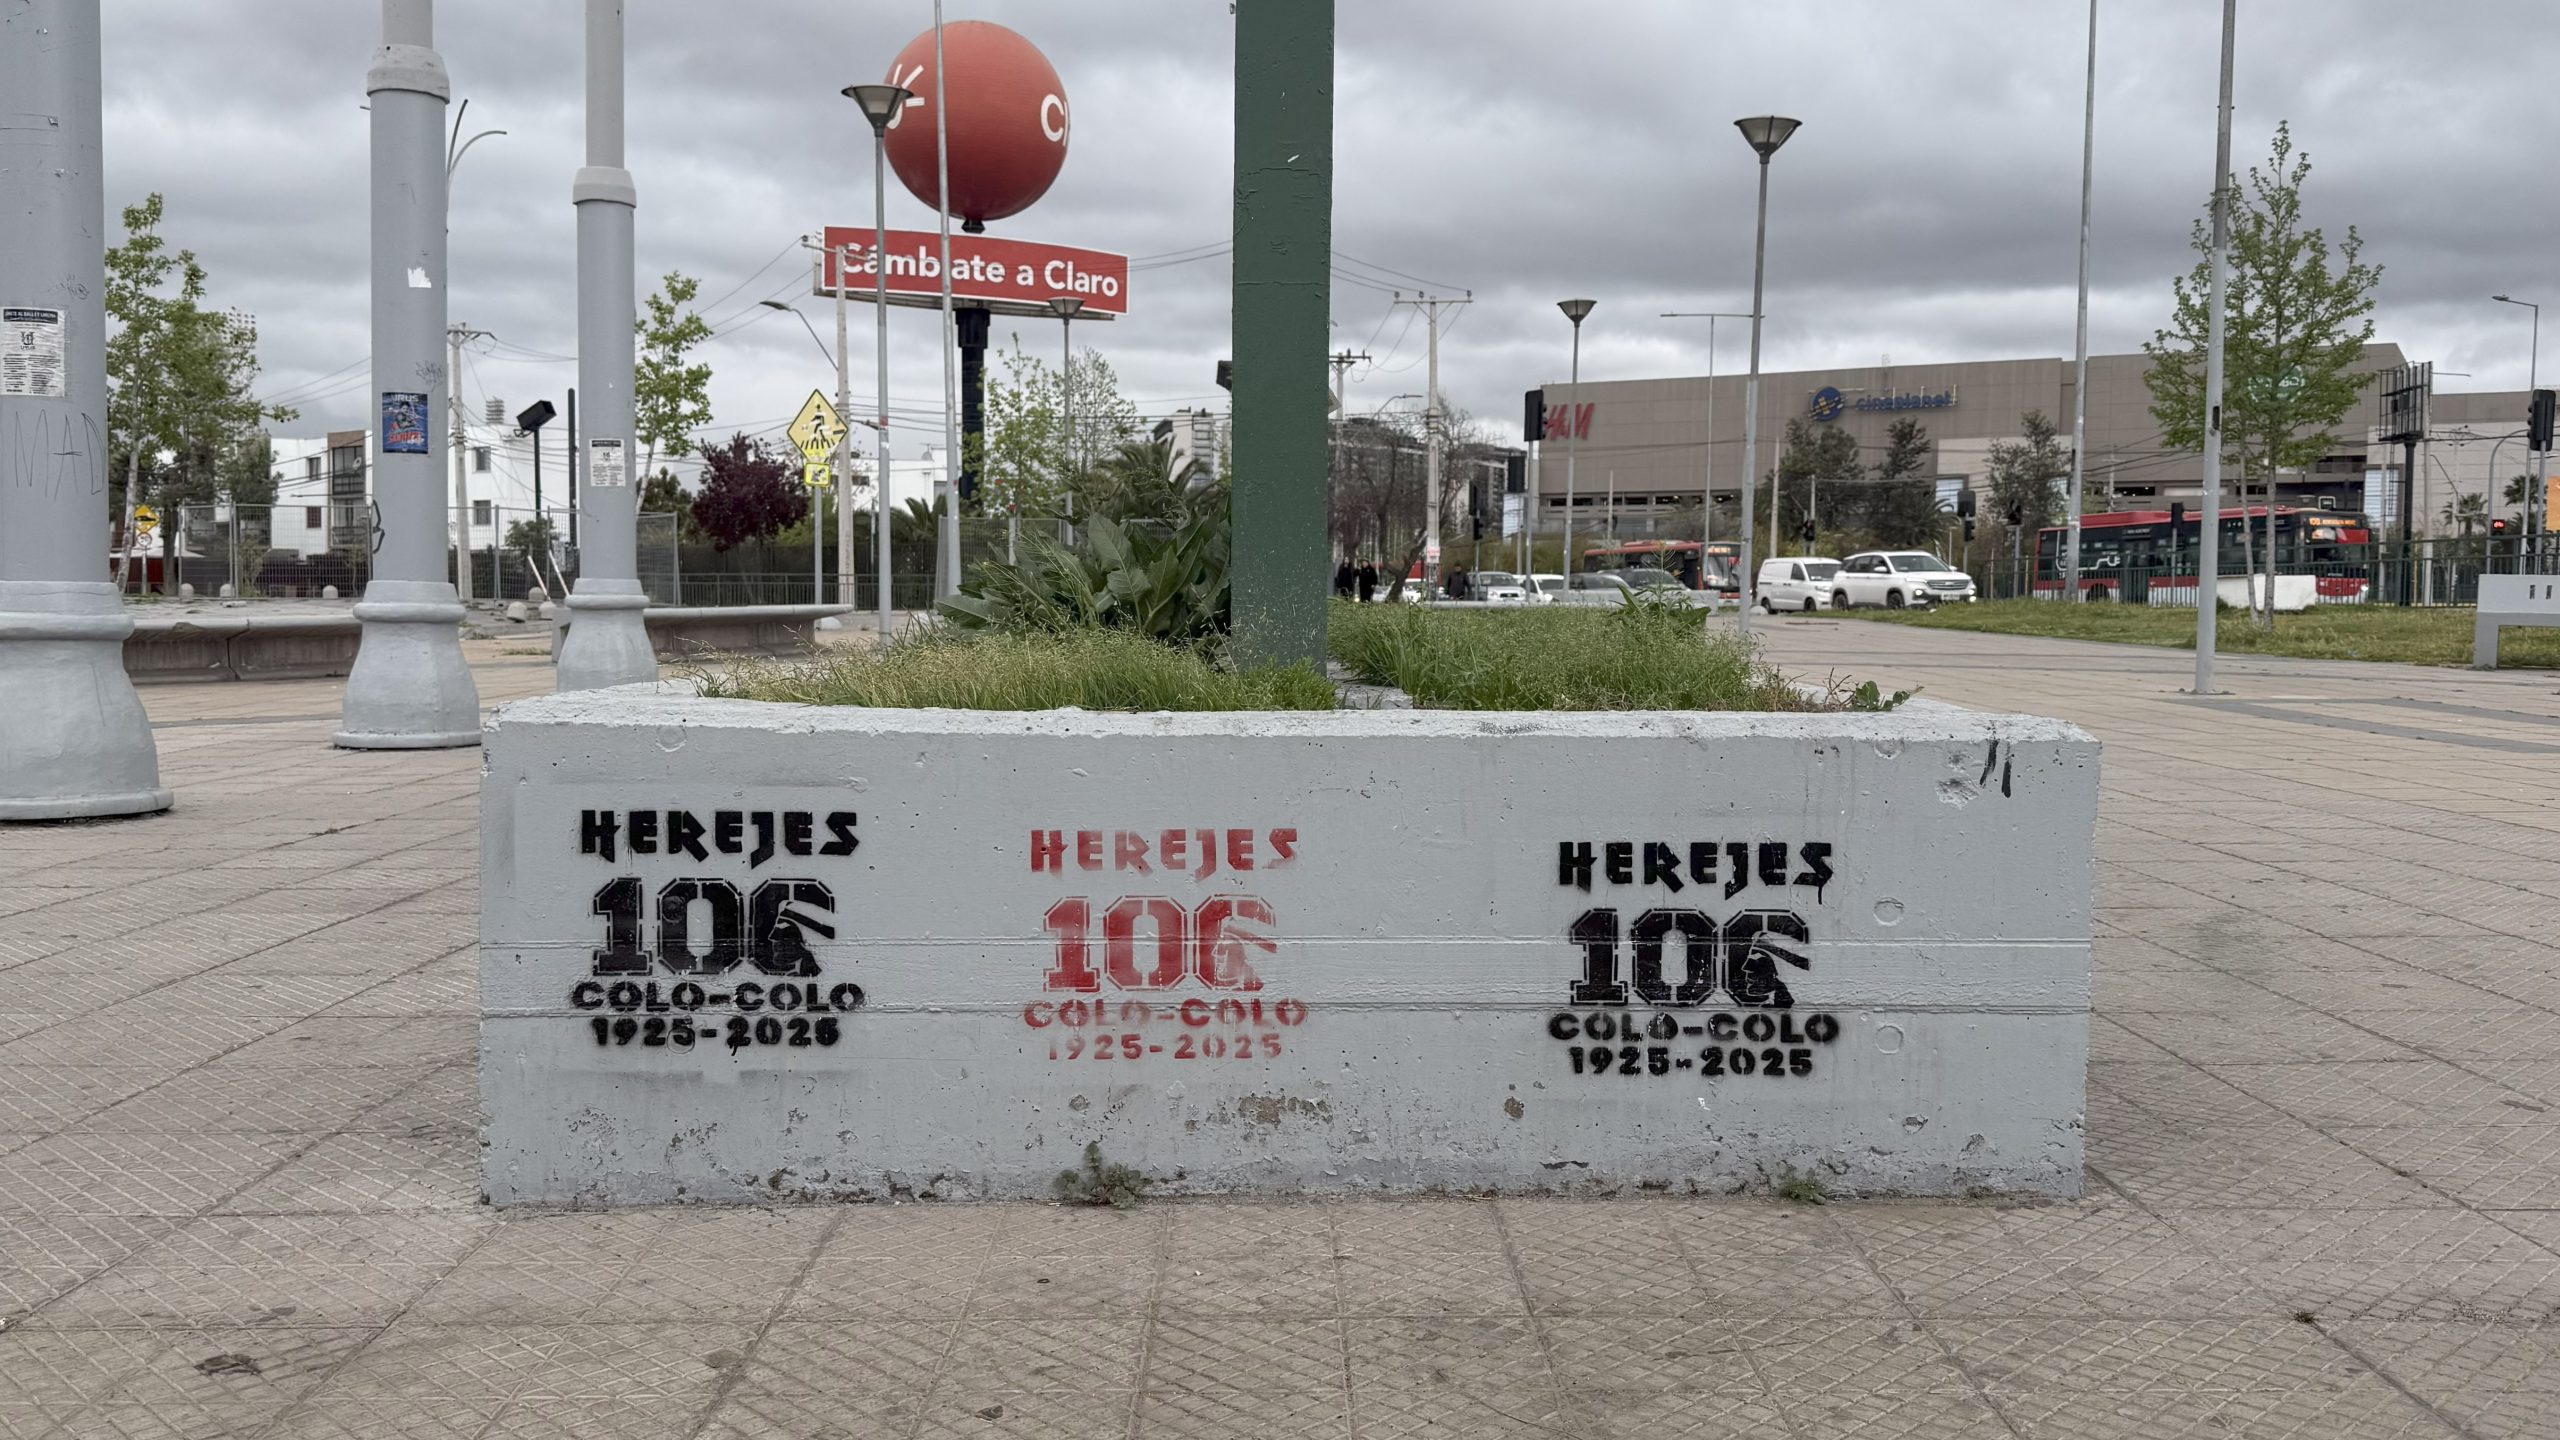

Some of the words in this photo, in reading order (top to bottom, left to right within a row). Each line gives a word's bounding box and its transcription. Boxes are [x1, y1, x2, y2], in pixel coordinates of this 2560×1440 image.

[843, 242, 1006, 283] Cámbate
[1016, 265, 1034, 286] a
[1044, 260, 1119, 297] Claro
[581, 810, 860, 870] HEREJES
[1031, 828, 1298, 882] HEREJES
[1559, 842, 1834, 901] HEREJES
[571, 980, 867, 1012] COLO-COLO
[1023, 998, 1308, 1029] COLO-COLO
[1549, 1012, 1840, 1044] COLO-COLO
[1048, 1033, 1282, 1061] 1925-2025
[1569, 1046, 1814, 1077] 1925-2025
